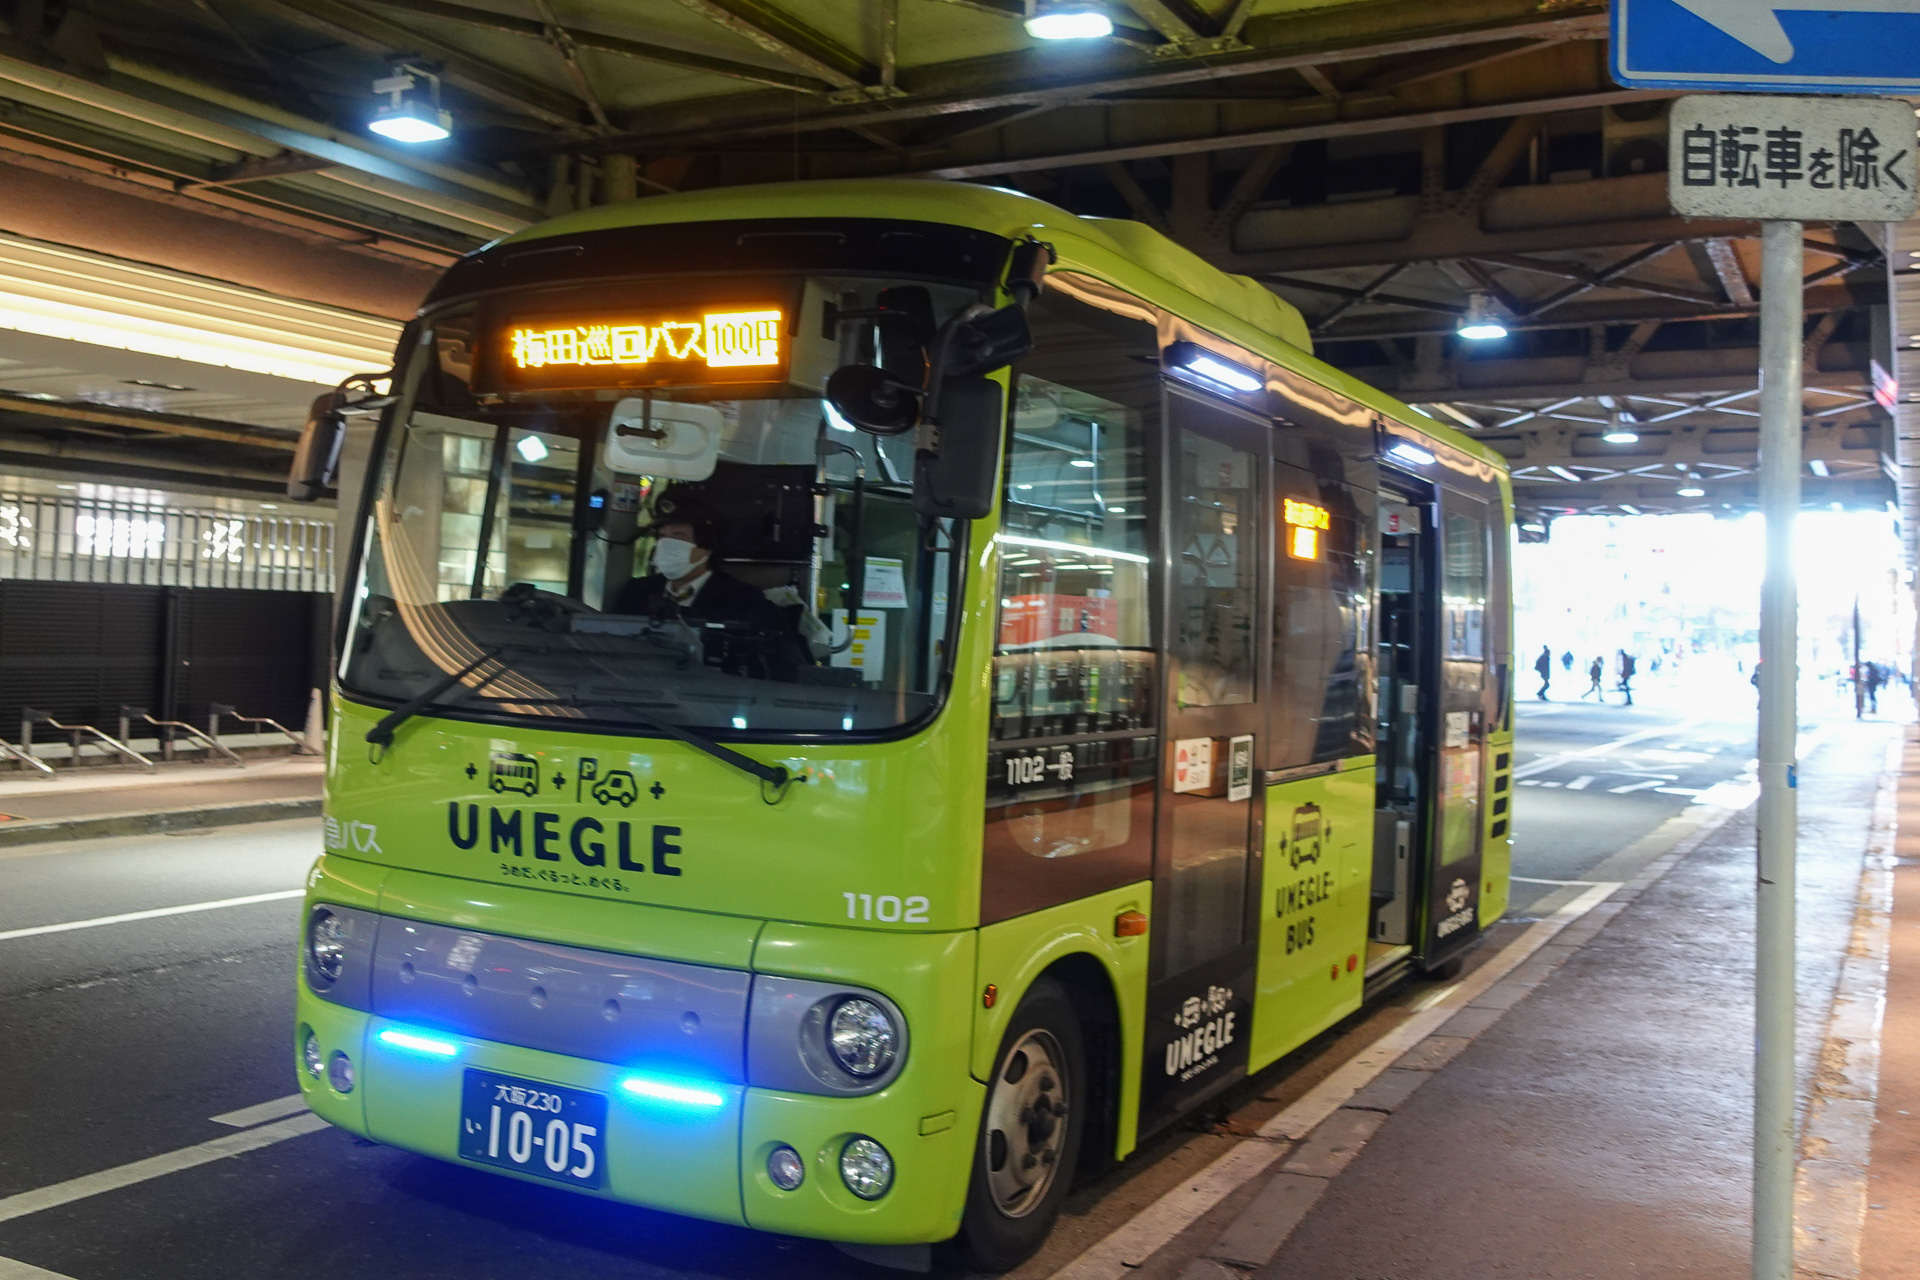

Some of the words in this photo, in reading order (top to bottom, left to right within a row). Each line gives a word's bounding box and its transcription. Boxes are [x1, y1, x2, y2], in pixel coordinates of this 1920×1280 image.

[1683, 123, 1908, 190] 自転車を除く
[706, 312, 781, 367] 100円
[449, 801, 682, 876] UMEGLE
[842, 891, 929, 923] 1102
[1165, 1011, 1235, 1076] UMEGLE
[464, 1117, 482, 1134] い
[488, 1104, 598, 1178] 10-05
